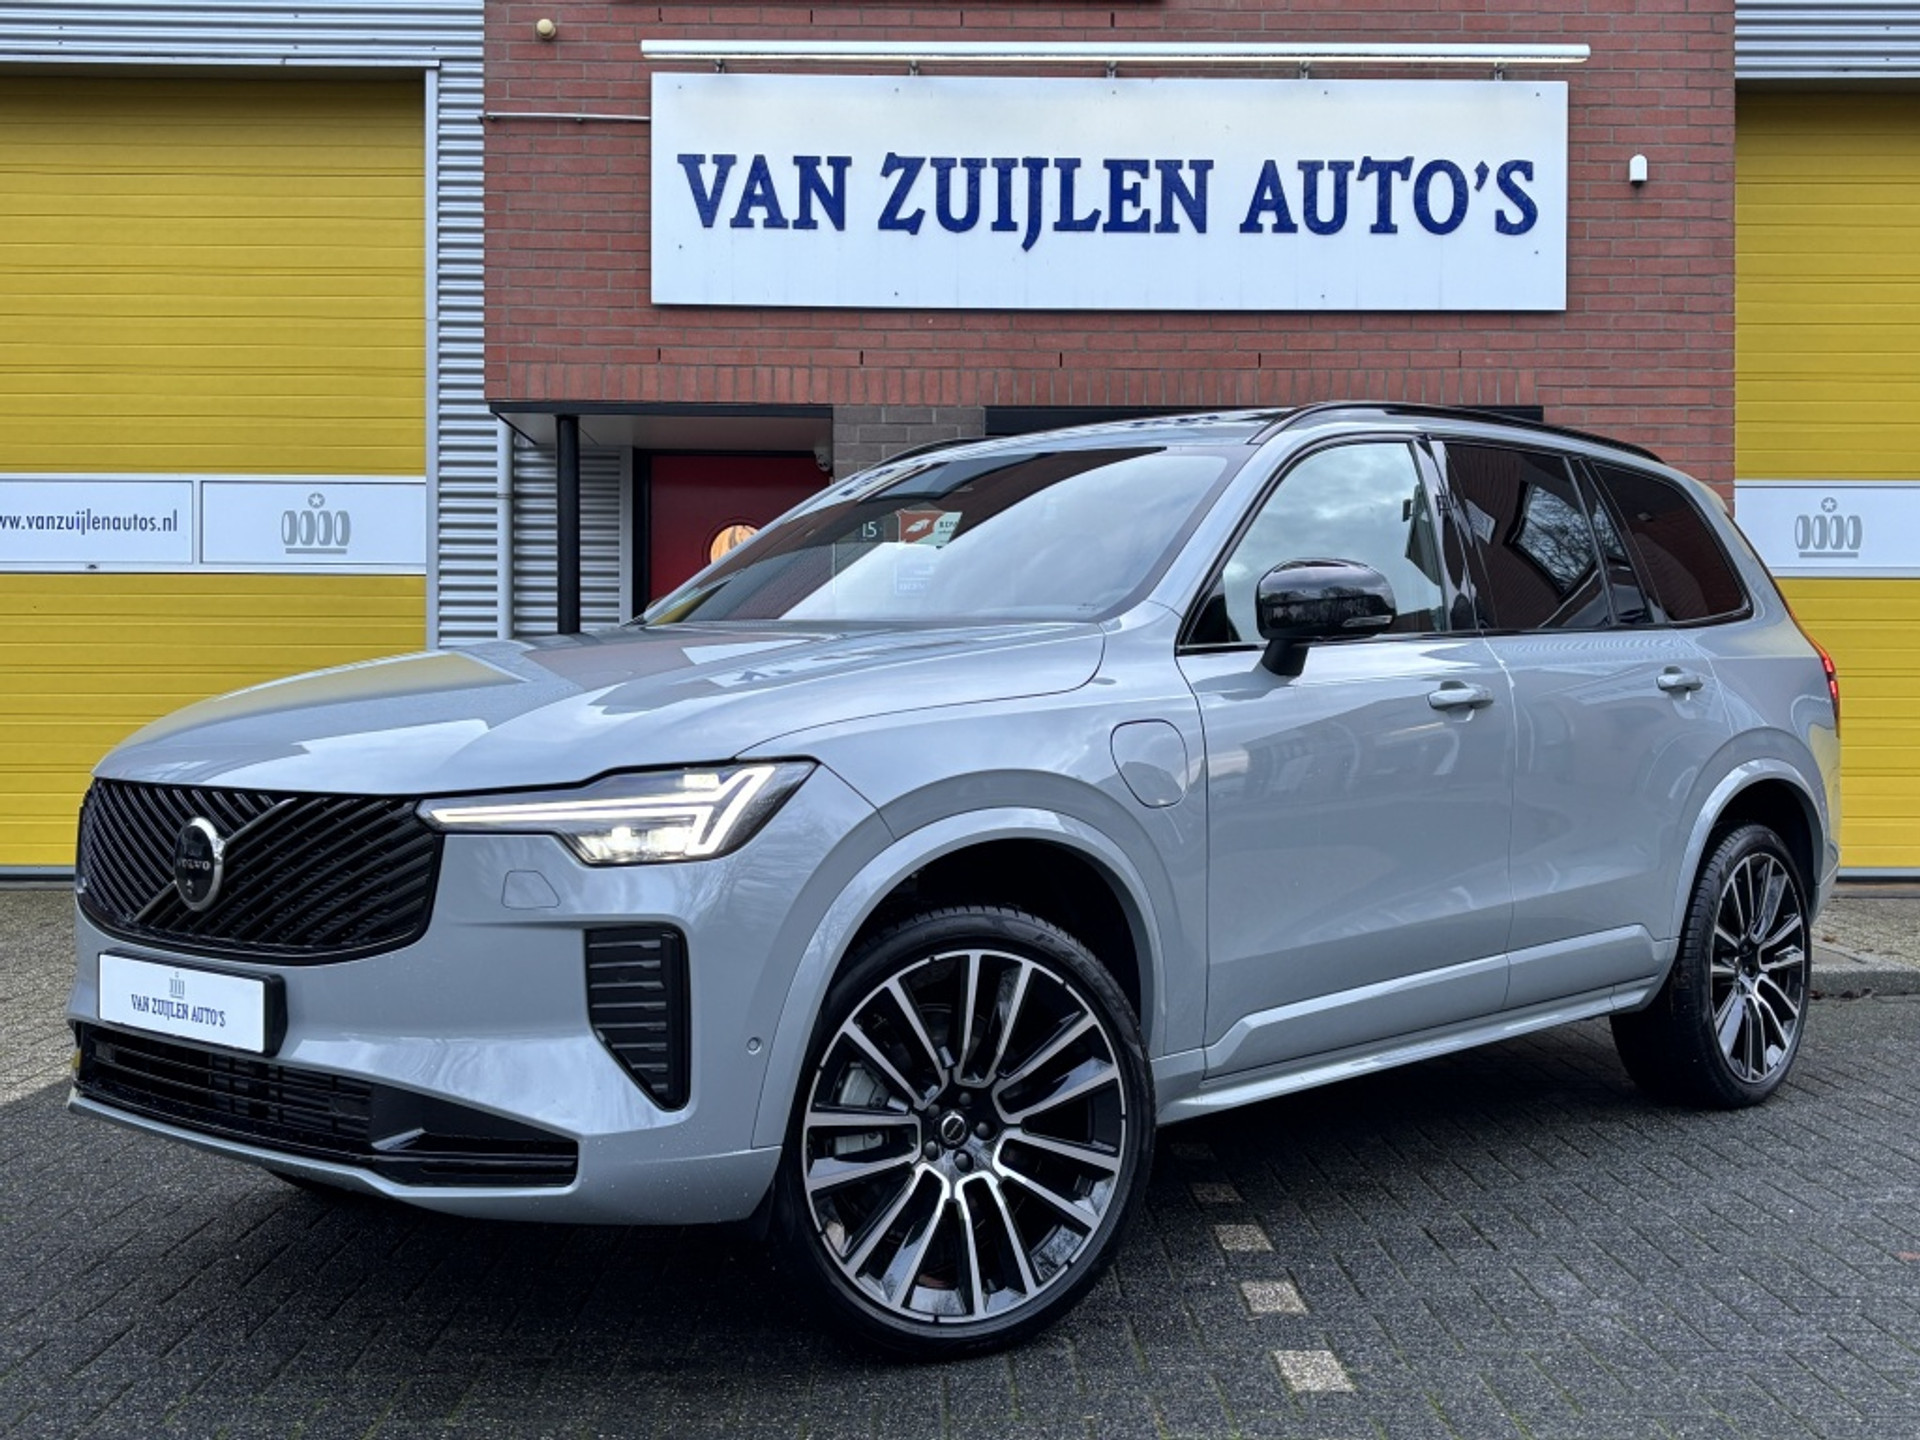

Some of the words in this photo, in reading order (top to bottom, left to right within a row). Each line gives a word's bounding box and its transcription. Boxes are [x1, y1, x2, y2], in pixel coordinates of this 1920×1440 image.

[677, 153, 853, 232] VAN
[877, 152, 1215, 252] ZUIJLEN
[1239, 156, 1539, 236] AUTO'S
[862, 521, 877, 538] 15
[131, 993, 150, 1012] VAN
[151, 997, 189, 1021] ZUIJLEN
[190, 1005, 226, 1027] AUTO'S
